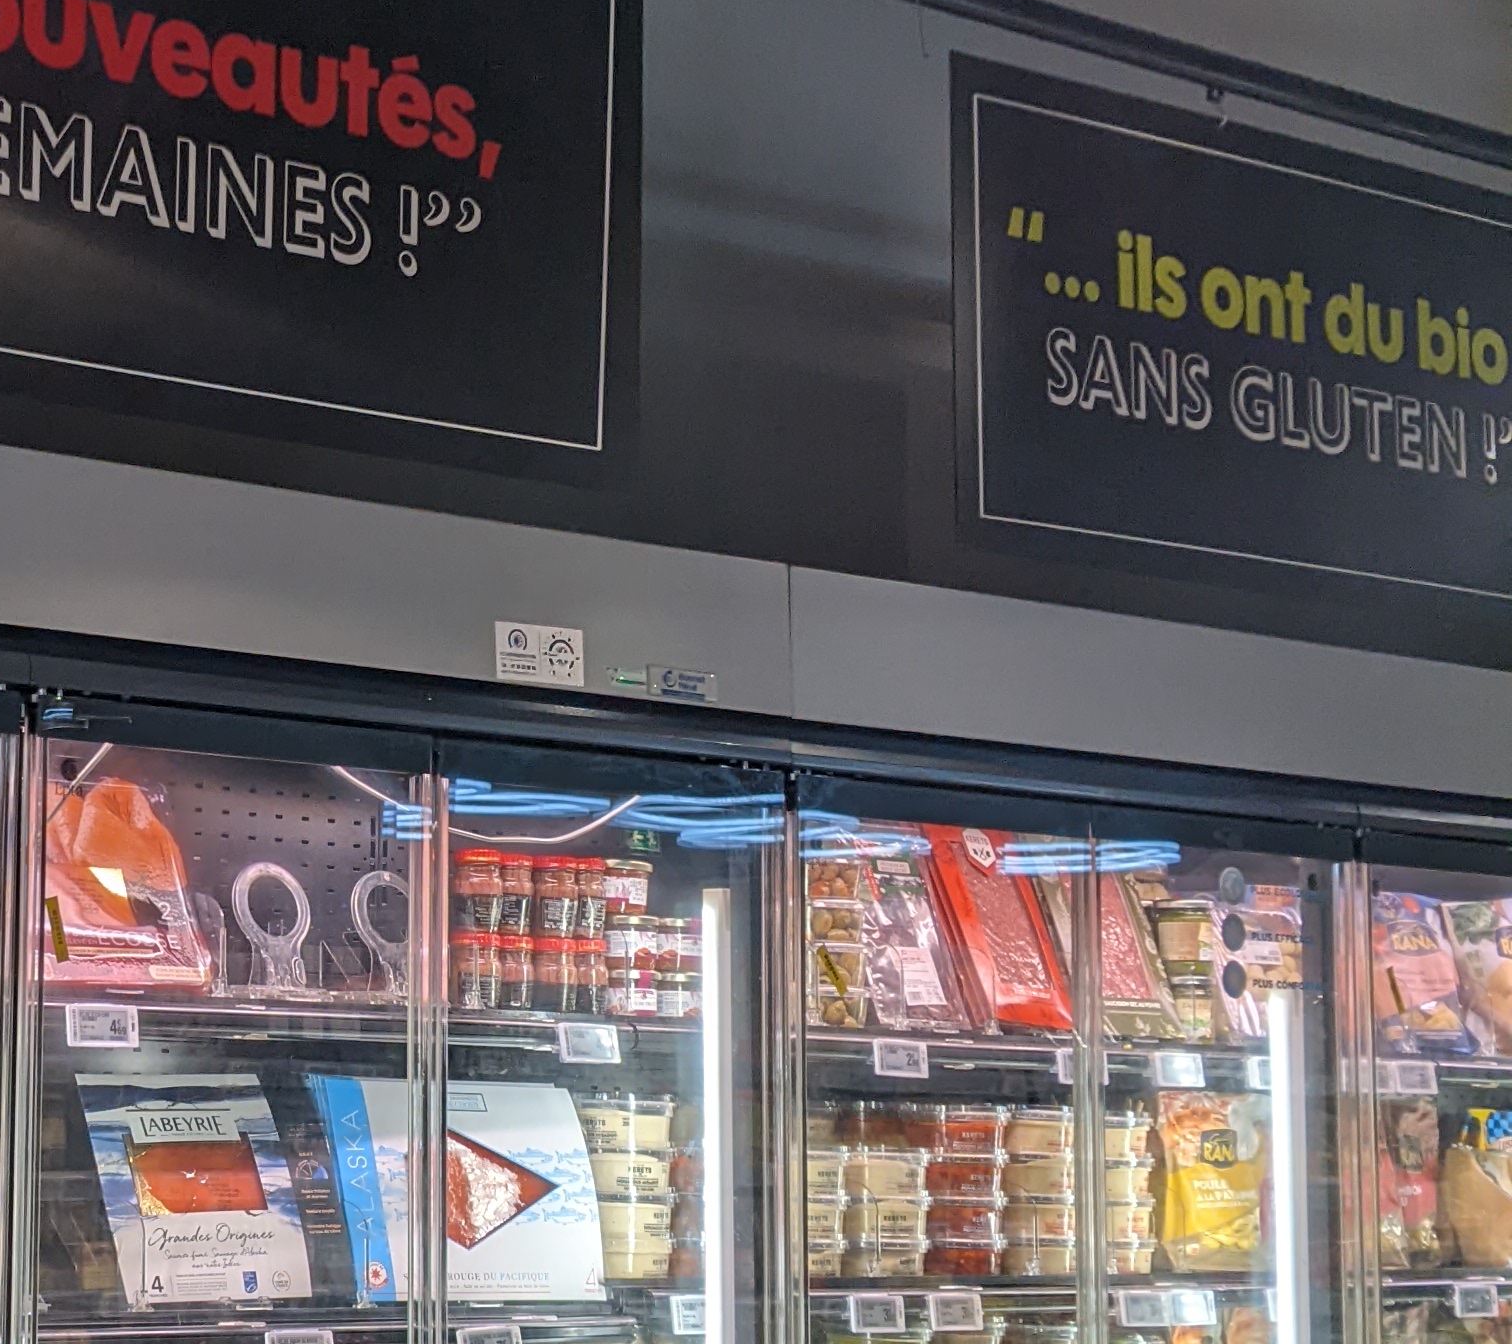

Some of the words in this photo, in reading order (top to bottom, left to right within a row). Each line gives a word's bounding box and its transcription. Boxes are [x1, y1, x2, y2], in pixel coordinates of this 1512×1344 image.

[1118, 229, 1186, 319] ils
[1200, 267, 1311, 343] ont
[1324, 283, 1403, 363] du
[1417, 298, 1508, 385] bio
[1047, 328, 1212, 430] SANS
[1230, 366, 1468, 479] GLUTEN
[1251, 931, 1268, 942] PLUS
[1252, 978, 1268, 989] PLUS
[139, 1114, 228, 1138] LABEYRIE
[340, 1109, 374, 1232] ALASKA
[147, 1225, 214, 1251] Grandes
[215, 1222, 276, 1246] Origines
[151, 1276, 165, 1294] 4
[448, 1271, 482, 1281] ROUGE
[484, 1271, 498, 1281] DU
[499, 1271, 551, 1282] PACIFIQUE
